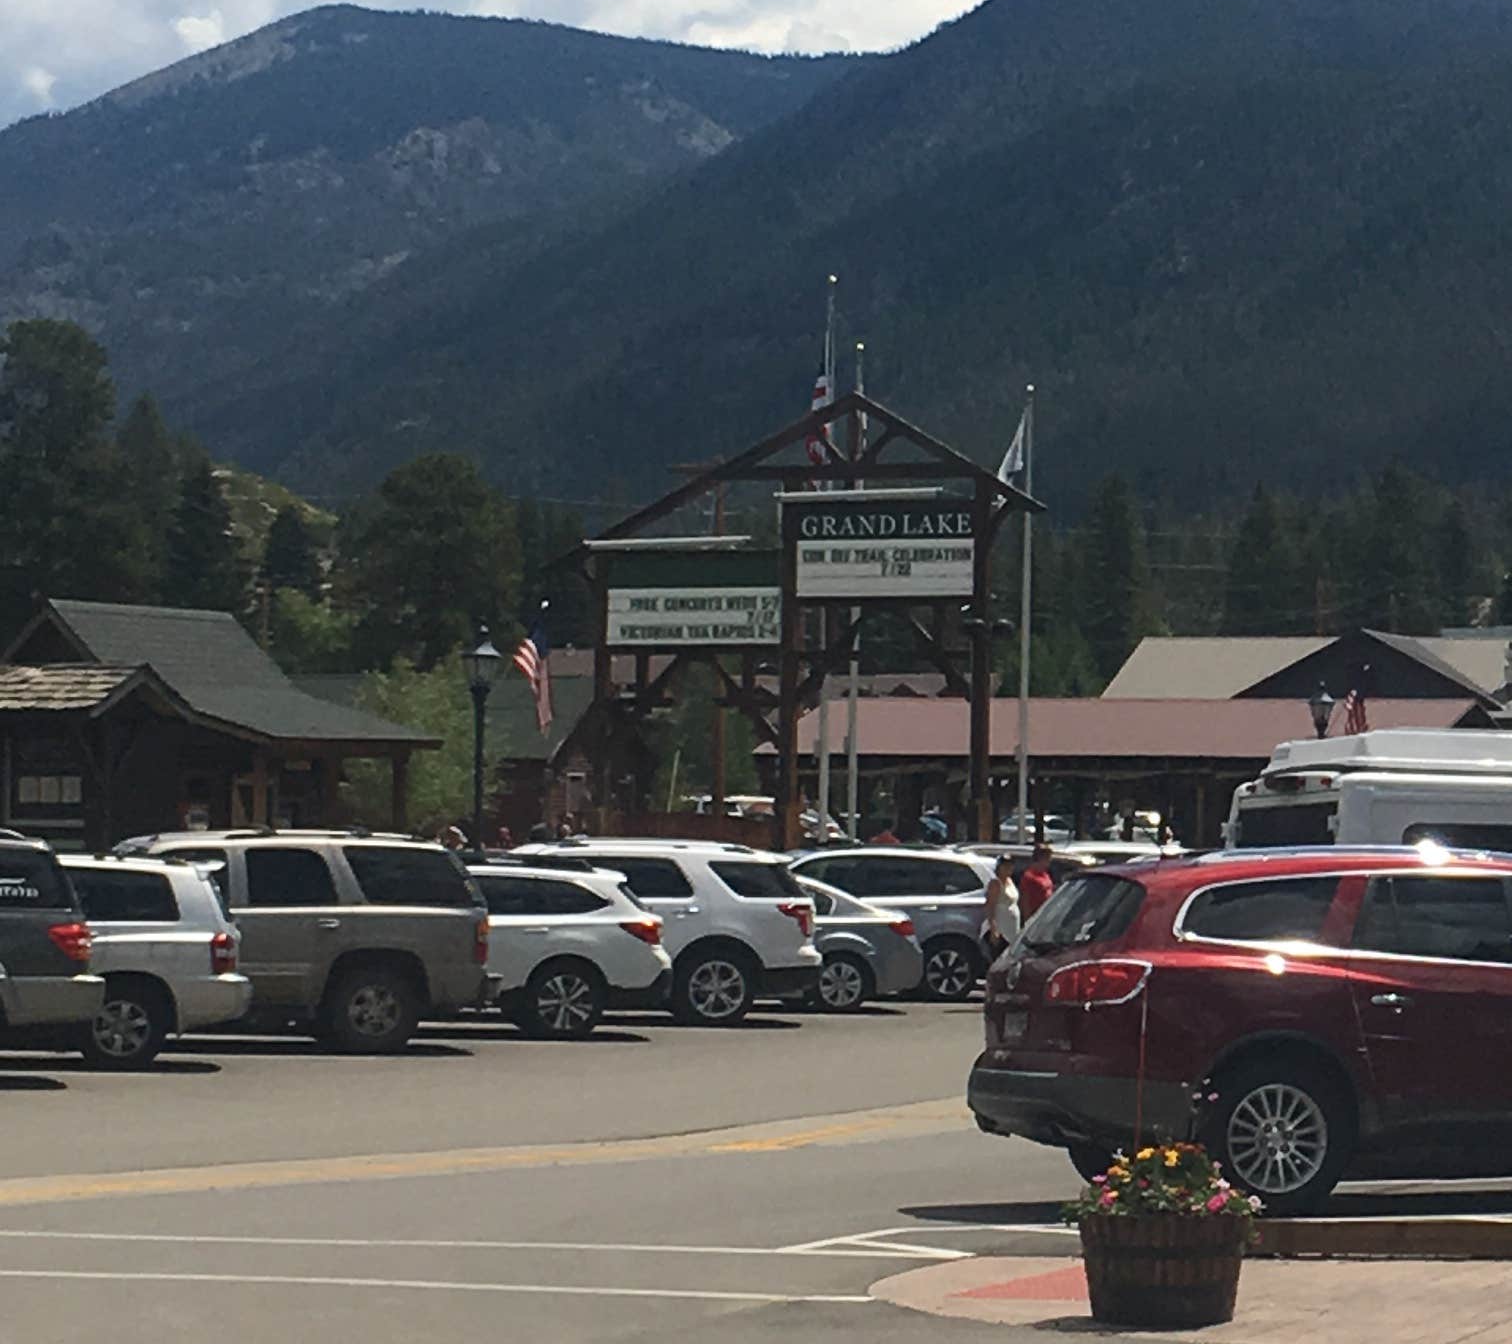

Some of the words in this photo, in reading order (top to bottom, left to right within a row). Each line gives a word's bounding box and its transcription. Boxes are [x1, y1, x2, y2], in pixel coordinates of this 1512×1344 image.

[801, 515, 896, 537] GRAND
[902, 513, 972, 535] LAKE
[853, 548, 886, 562] TRAIL
[893, 547, 972, 562] CELEBRATION
[630, 598, 658, 612] FREE
[664, 597, 722, 611] CONCERTS
[620, 625, 683, 638] VICTORIAN
